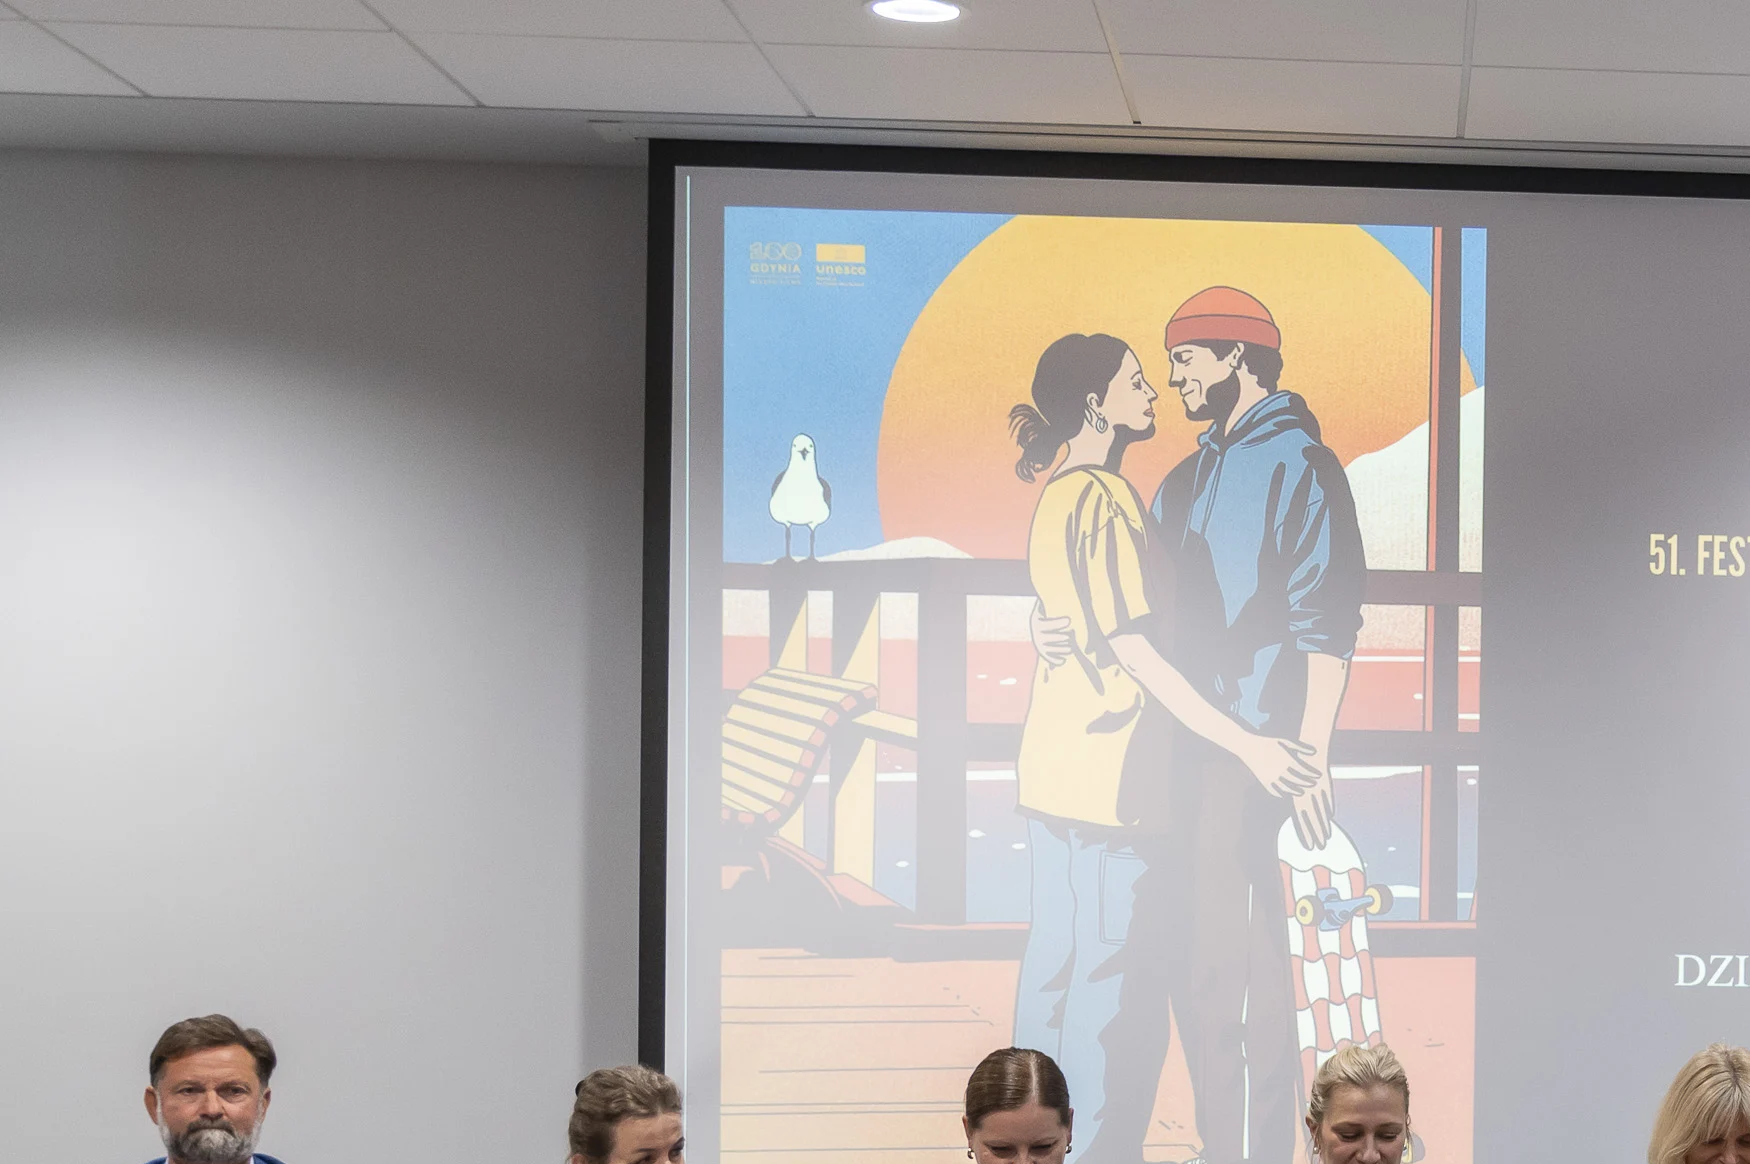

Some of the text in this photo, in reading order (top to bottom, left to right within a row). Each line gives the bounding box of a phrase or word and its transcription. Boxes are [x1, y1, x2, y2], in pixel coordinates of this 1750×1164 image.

[750, 263, 802, 273] GDYNIA
[816, 265, 867, 276] unesco
[1648, 533, 1686, 577] 51.
